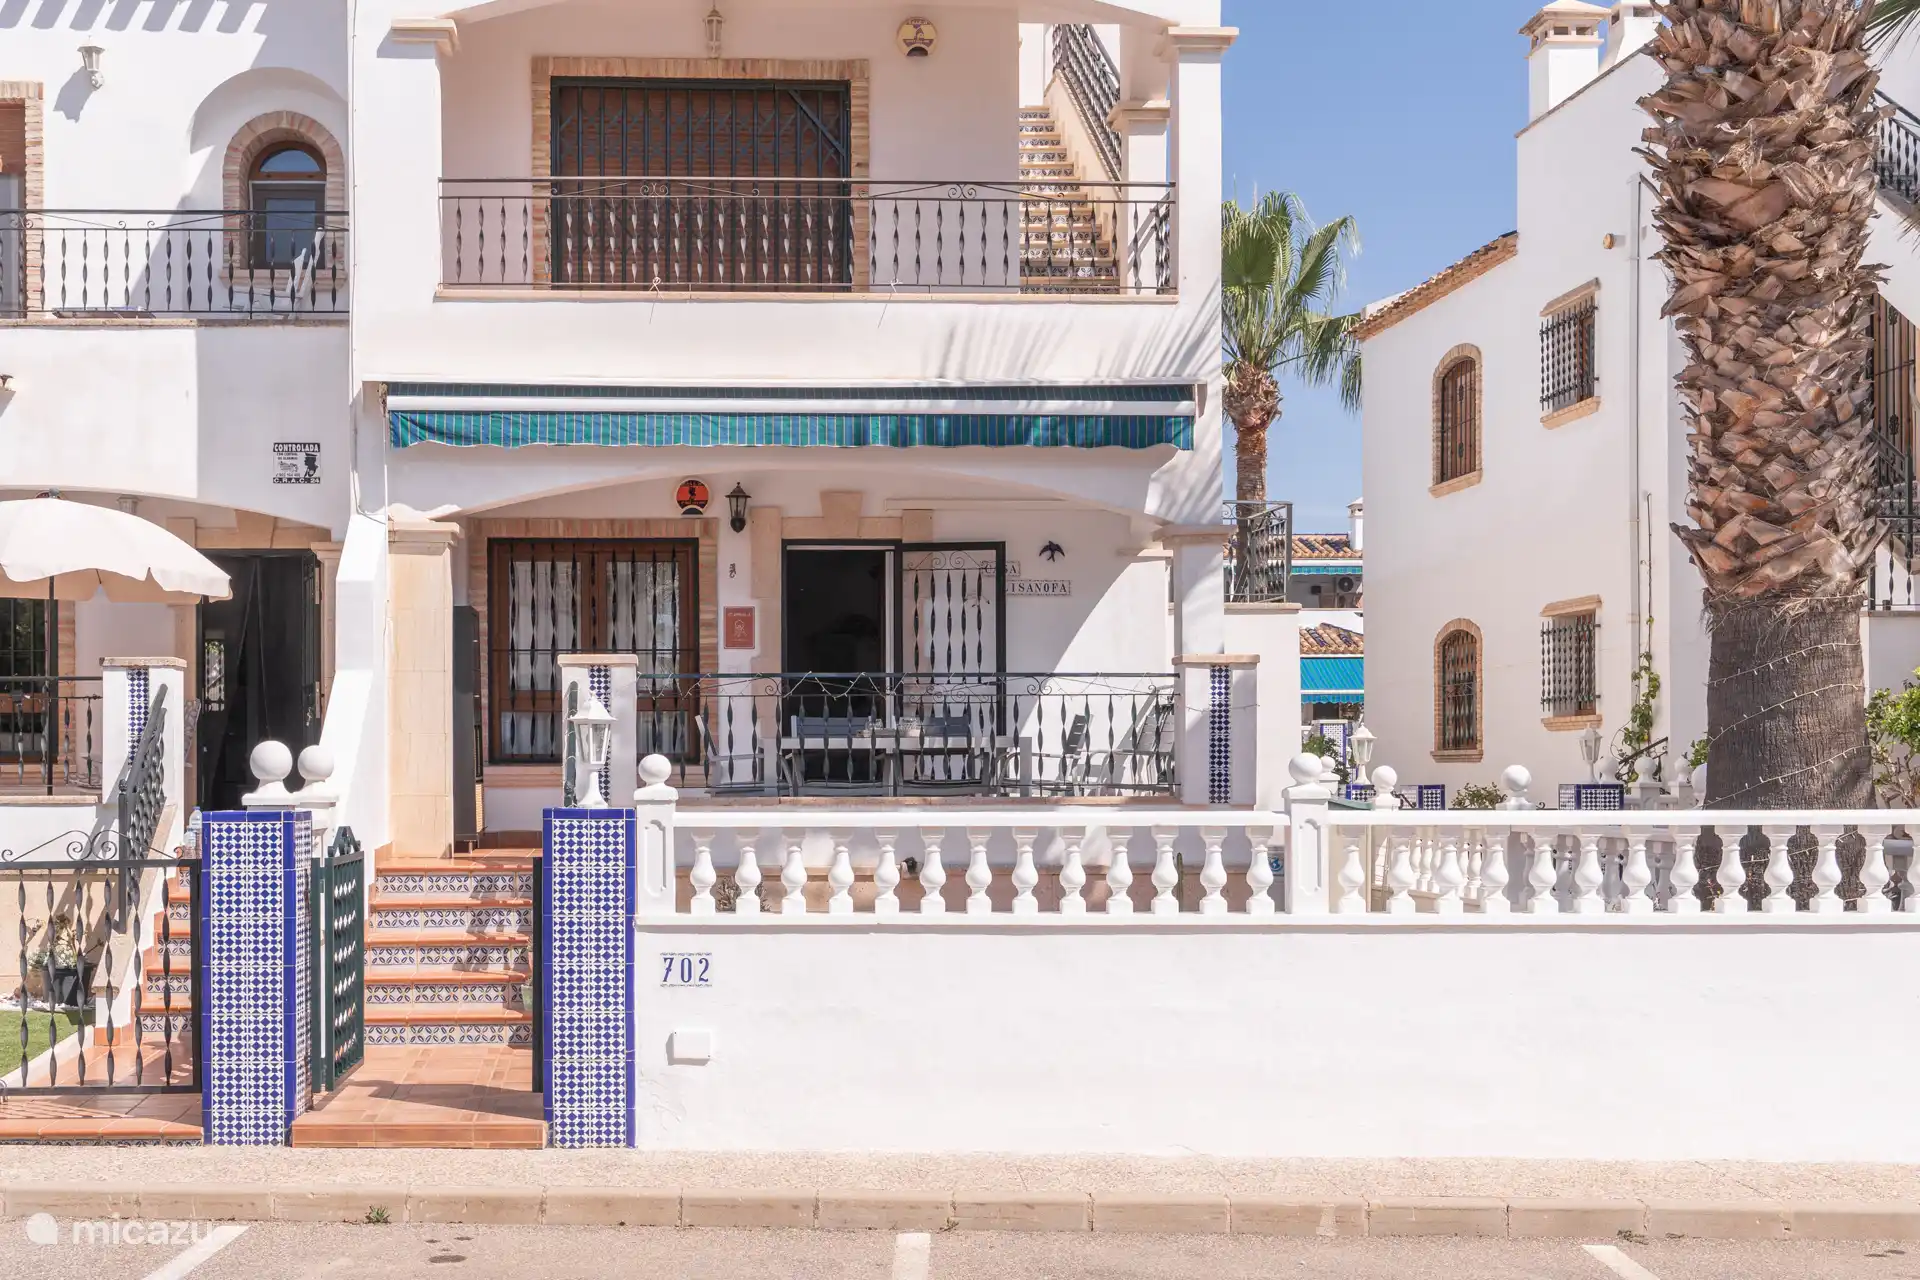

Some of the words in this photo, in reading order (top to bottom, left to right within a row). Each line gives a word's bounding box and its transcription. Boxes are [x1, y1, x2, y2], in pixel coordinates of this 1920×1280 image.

[274, 443, 319, 452] CONTROLADA
[984, 564, 1017, 574] CA
[662, 957, 710, 983] 702
